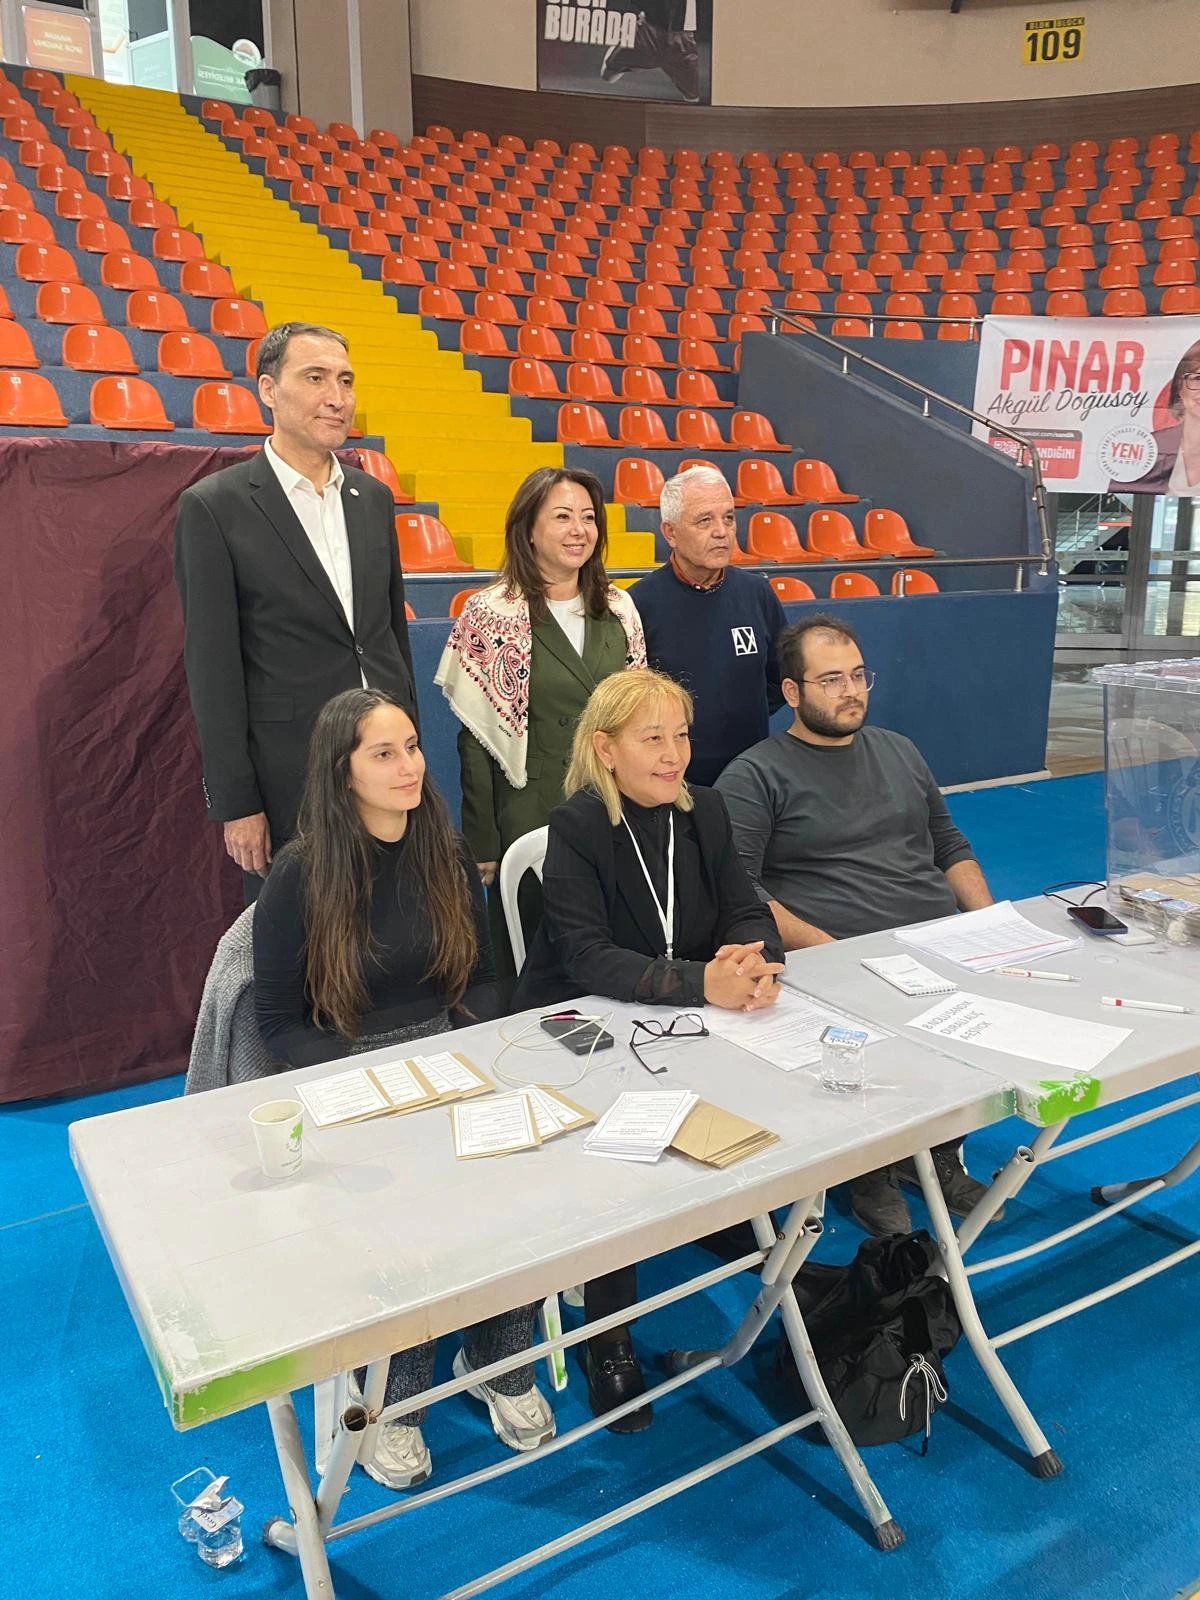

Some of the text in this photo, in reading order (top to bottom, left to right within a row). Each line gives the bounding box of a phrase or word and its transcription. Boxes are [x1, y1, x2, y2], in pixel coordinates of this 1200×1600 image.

[544, 4, 638, 49] BURADA
[1027, 28, 1082, 62] 109
[1000, 339, 1145, 393] PINAR
[987, 389, 1149, 425] Akgül Doğusoy
[1036, 446, 1076, 460] ANDIĞINI
[1111, 442, 1145, 461] YENİ
